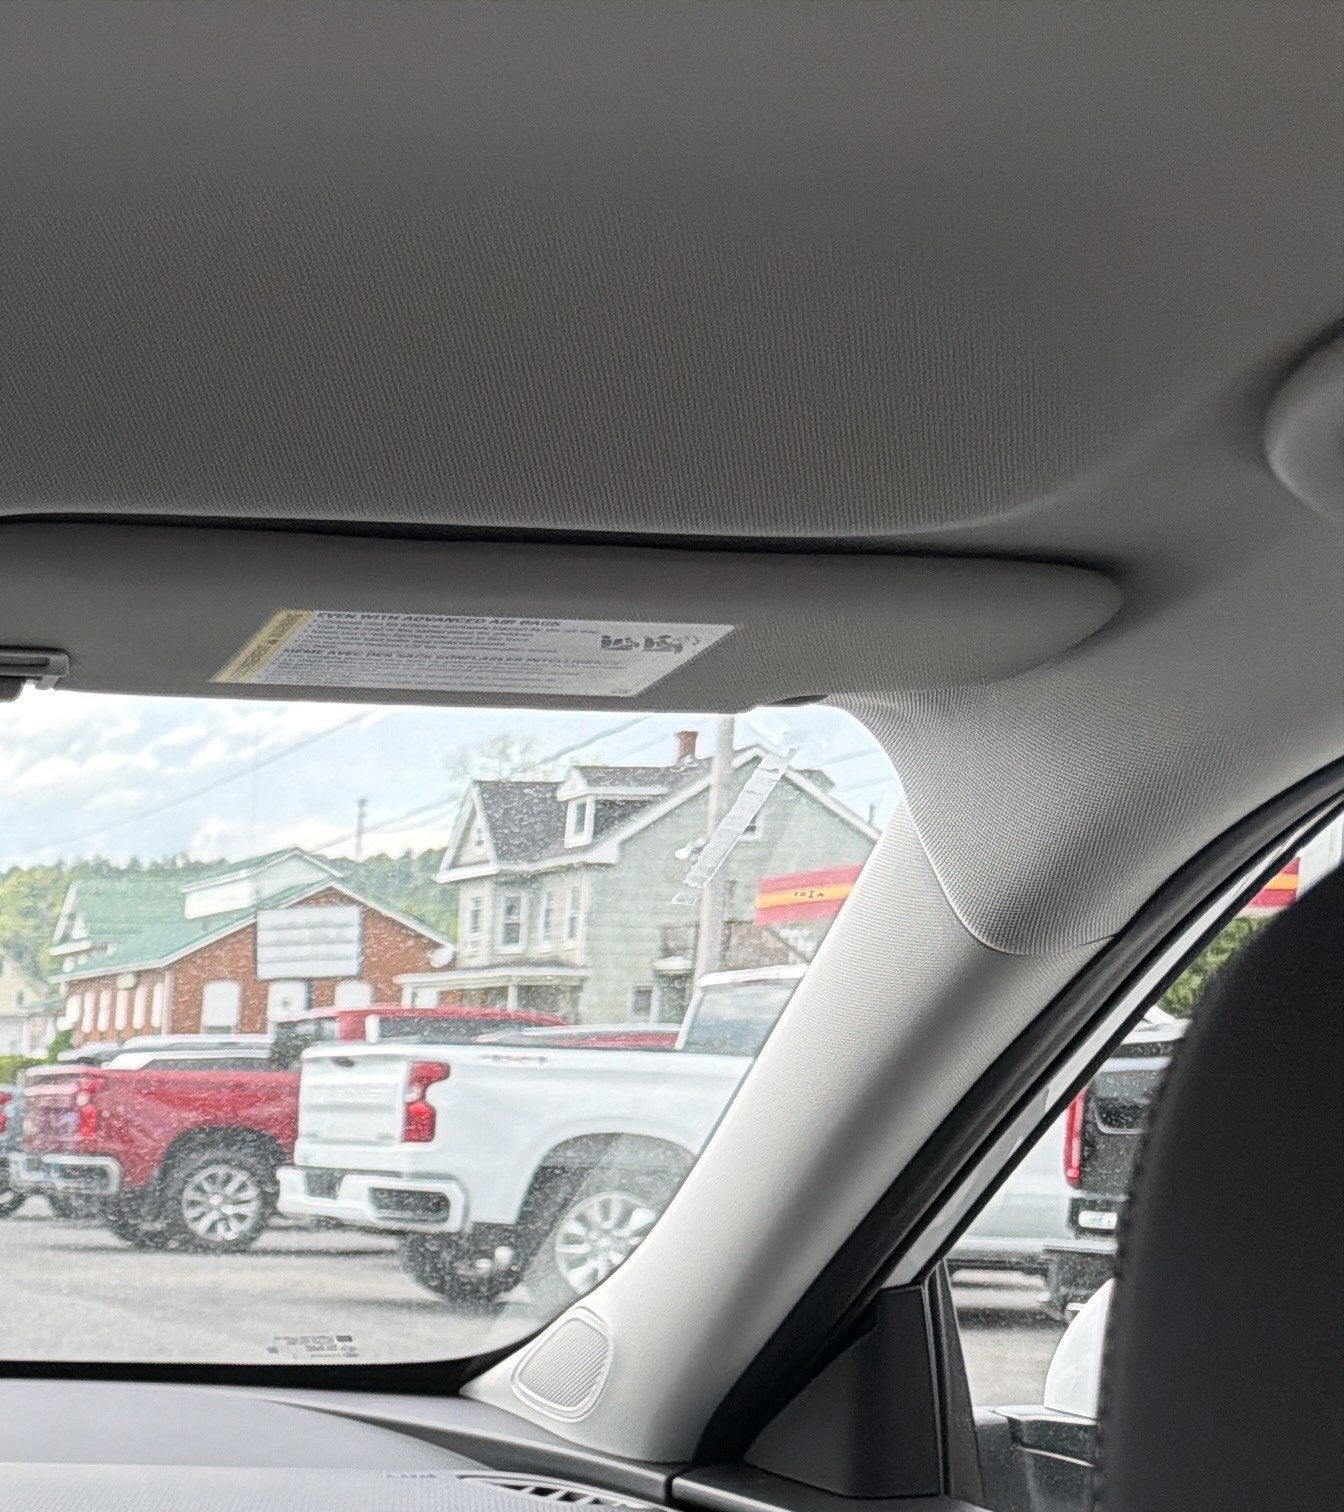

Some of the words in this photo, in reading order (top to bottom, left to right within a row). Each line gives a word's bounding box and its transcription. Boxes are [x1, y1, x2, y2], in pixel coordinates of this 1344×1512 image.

[316, 611, 355, 620] EVEN
[361, 613, 399, 621] WITH
[404, 615, 485, 624] ADVANCED
